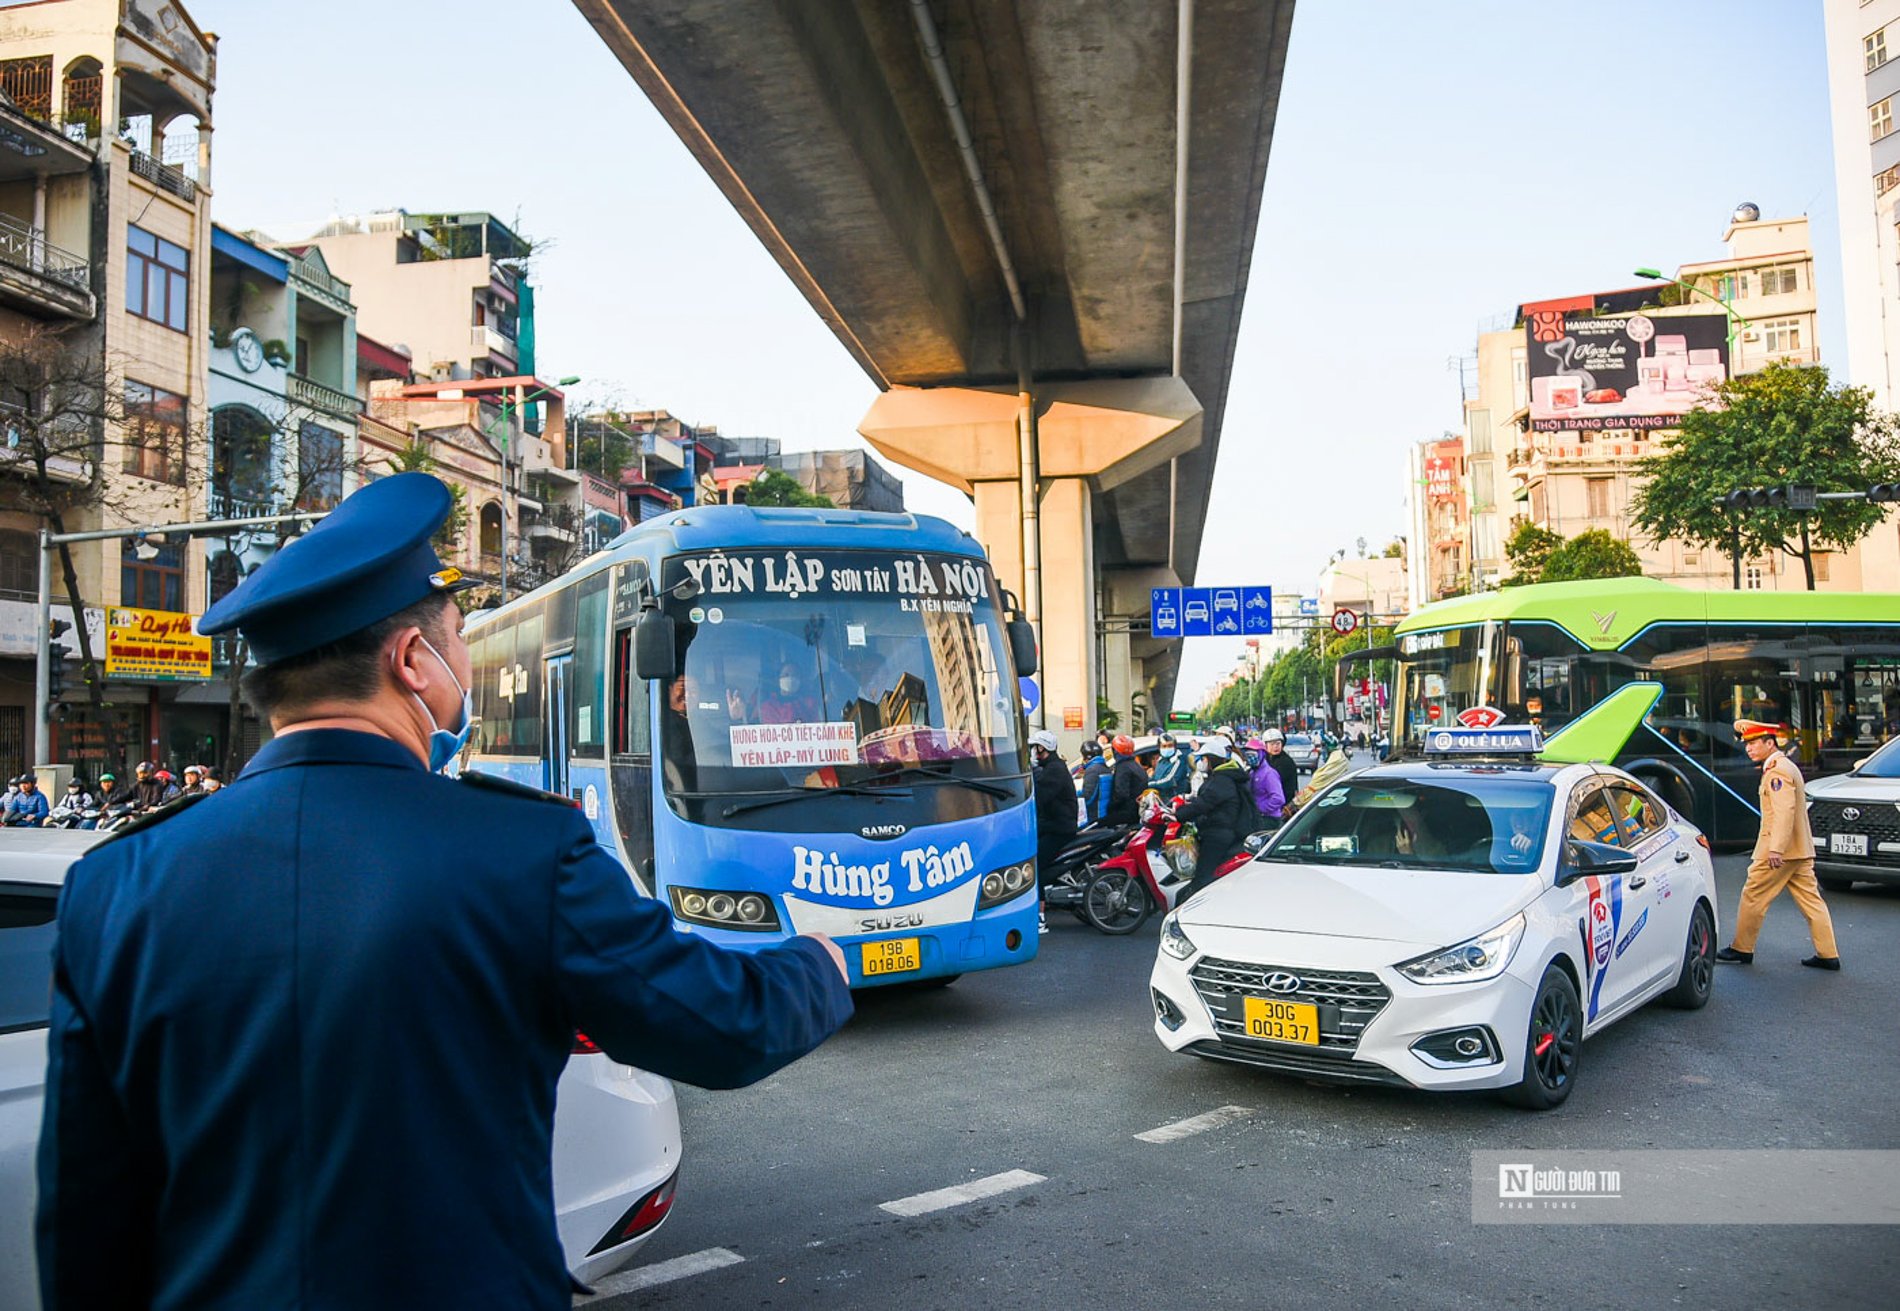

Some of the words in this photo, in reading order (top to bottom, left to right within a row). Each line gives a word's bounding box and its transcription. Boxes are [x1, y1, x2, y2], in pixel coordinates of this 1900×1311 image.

[1565, 320, 1626, 331] HAWONKOO
[1535, 419, 1561, 430] THỜI
[1564, 418, 1602, 429] TRANG
[1605, 418, 1626, 427] GIA
[1630, 416, 1663, 428] DỤNG
[1666, 415, 1682, 425] HÀ
[684, 549, 755, 595] YÊN
[762, 550, 825, 599] LẬP
[831, 568, 863, 592] SƠN
[864, 566, 890, 593] TÂY
[894, 554, 938, 594] HÀ
[941, 560, 989, 604] NỘI
[900, 599, 918, 612] B.X
[920, 597, 941, 612] YÊN
[818, 748, 850, 763] LUNG
[861, 824, 906, 836] SAMCO
[792, 846, 894, 906] Hùng
[901, 841, 974, 892] Tâm
[880, 942, 903, 956] 19B
[869, 956, 914, 973] 018.06
[1265, 1002, 1295, 1020] 30G
[1253, 1019, 1309, 1041] 003.37
